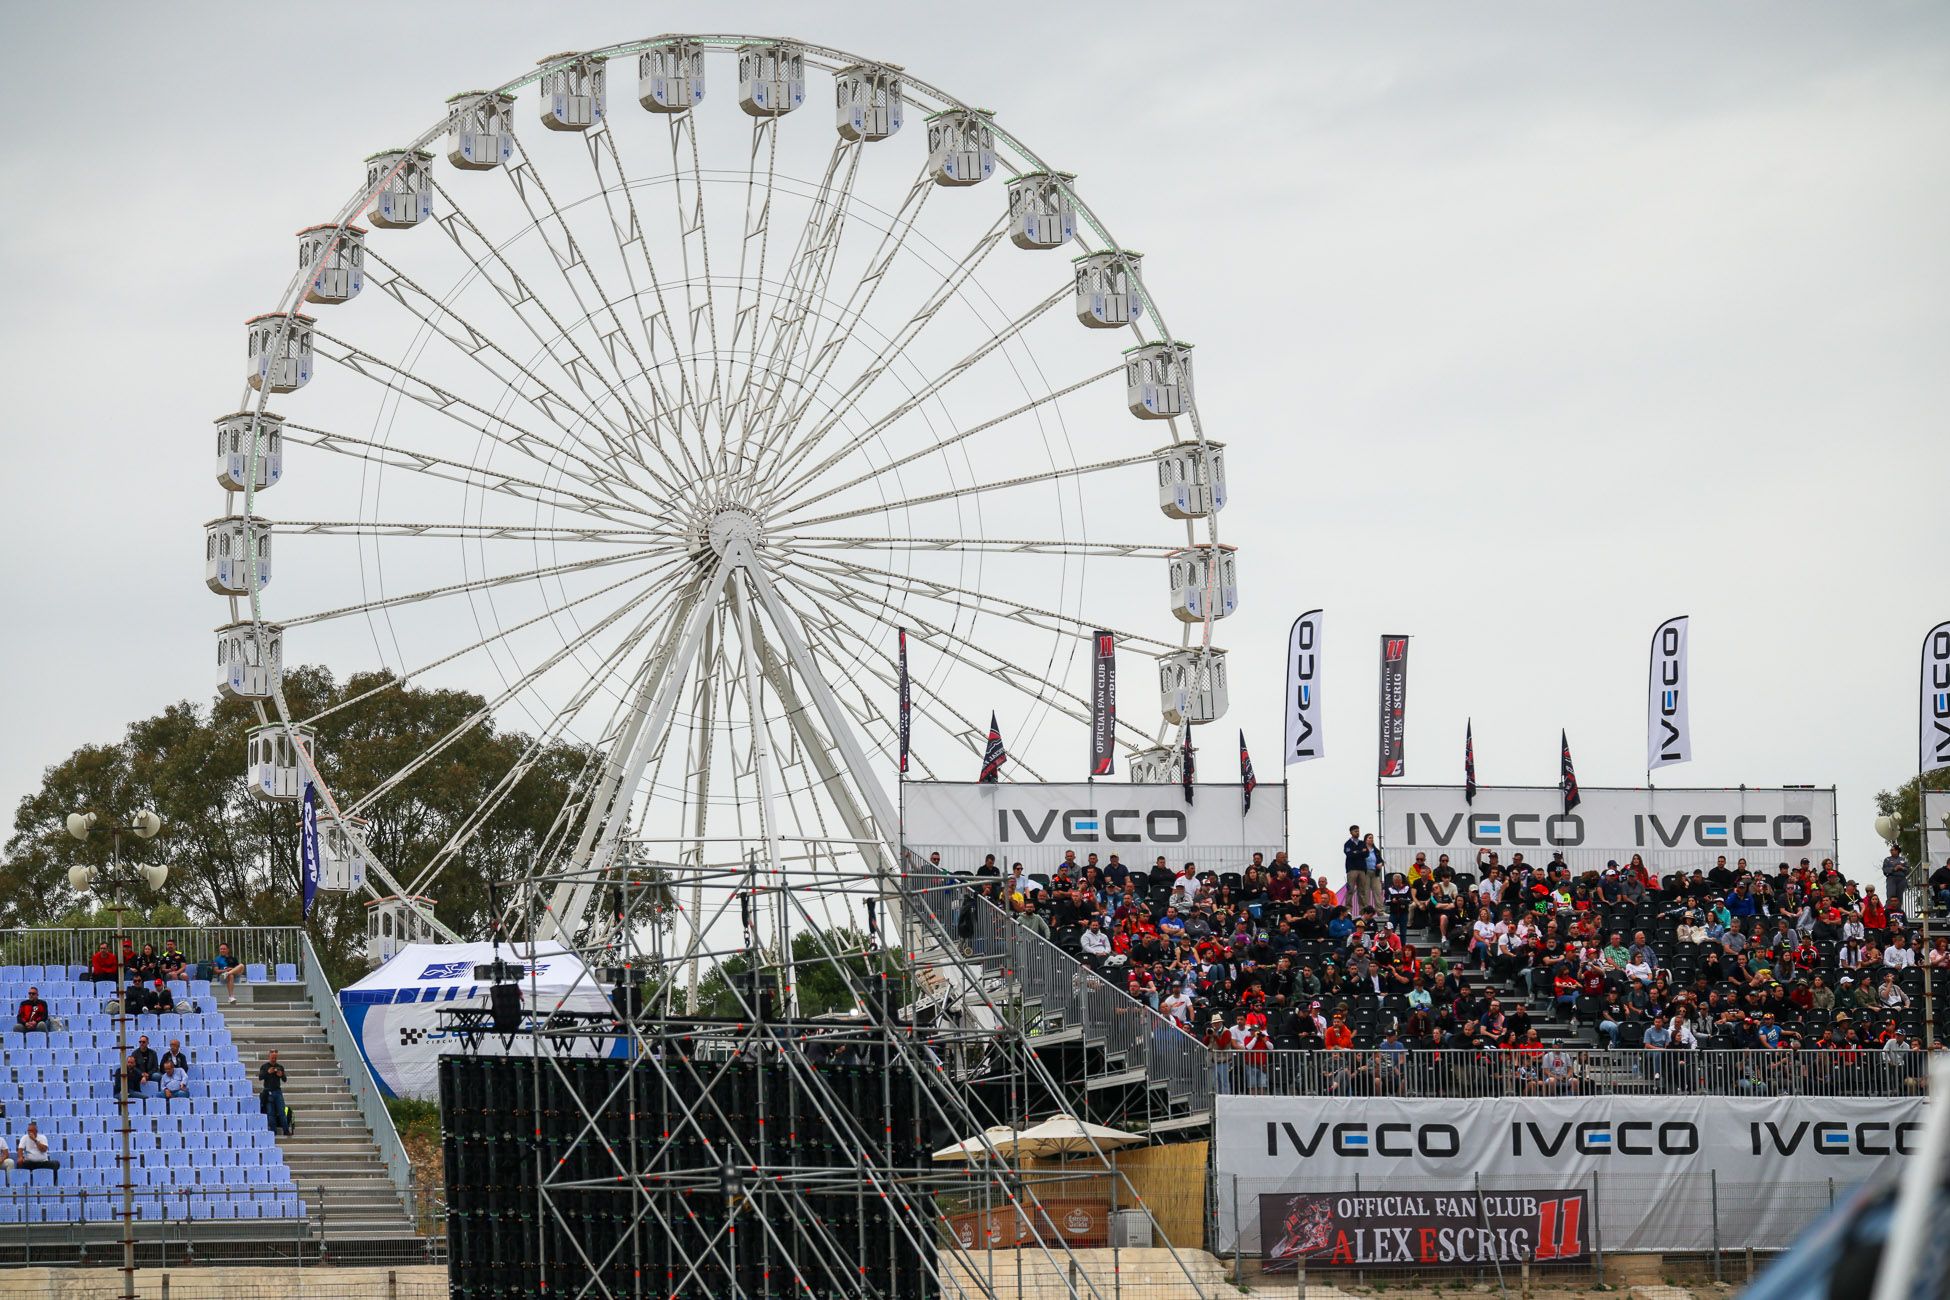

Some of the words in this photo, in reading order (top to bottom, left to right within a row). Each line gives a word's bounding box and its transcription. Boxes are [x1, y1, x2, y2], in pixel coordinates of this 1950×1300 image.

[1098, 635, 1113, 659] 11
[1385, 639, 1405, 662] 11
[1097, 690, 1105, 708] FAN
[1297, 621, 1315, 756] IVECO
[1661, 628, 1681, 760] IVECO
[1934, 631, 1950, 762] IVECO
[1096, 709, 1105, 753] OFFICIAL
[1383, 713, 1391, 756] OFFICIAL
[999, 809, 1187, 843] IVECO
[1407, 813, 1584, 846] IVECO
[1635, 815, 1811, 847] IVECO
[1267, 1122, 1459, 1157] IVECO
[1512, 1121, 1698, 1157] IVECO
[1751, 1121, 1926, 1156] IVECO
[1337, 1197, 1430, 1218] OFFICIAL
[1435, 1197, 1477, 1218] FAN
[1483, 1197, 1537, 1217] CLUB
[1330, 1227, 1414, 1264] ALEX
[1418, 1227, 1530, 1263] ESCRIG
[1534, 1196, 1582, 1262] 11
